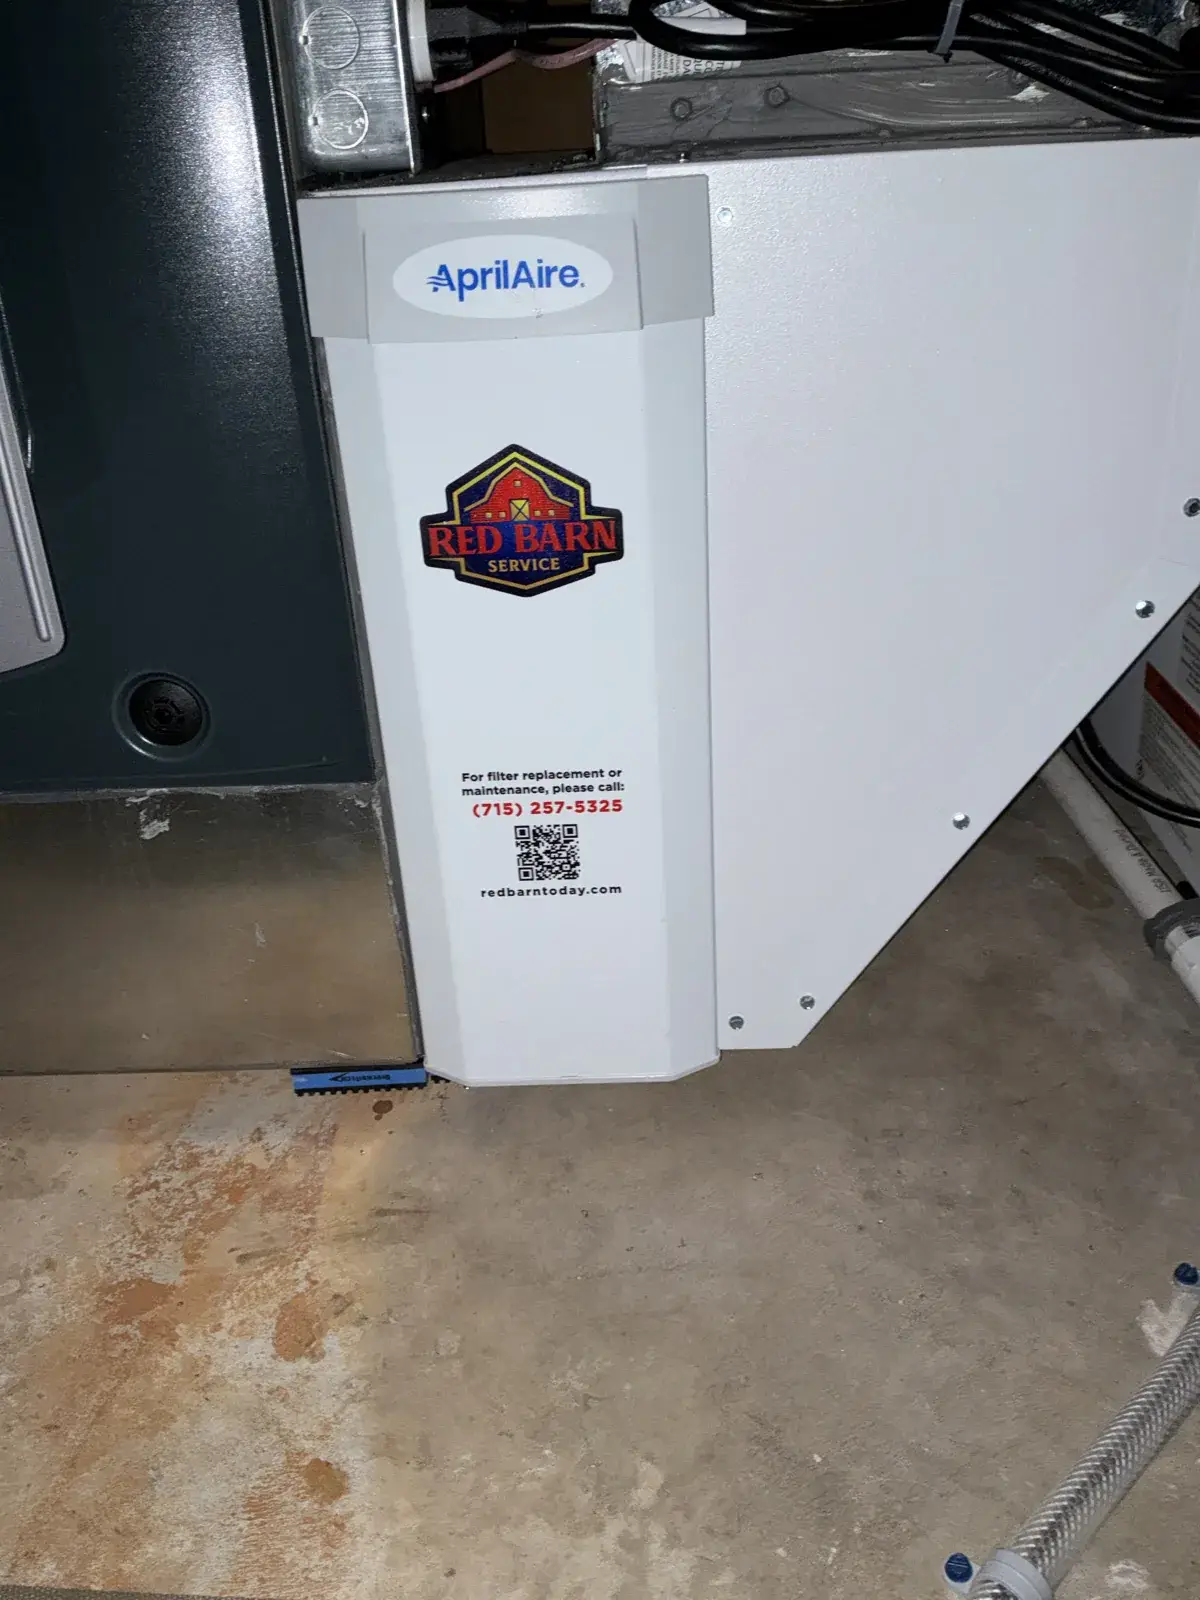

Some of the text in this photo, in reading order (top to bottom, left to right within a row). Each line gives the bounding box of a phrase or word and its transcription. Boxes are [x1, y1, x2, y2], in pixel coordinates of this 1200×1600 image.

[427, 259, 580, 302] AprilAire
[428, 520, 616, 556] RED BARN
[487, 557, 561, 573] SERVICE
[461, 769, 622, 783] For filter replacement or
[461, 781, 625, 797] maintenance, please call:
[472, 799, 623, 818] (715) 257-5325
[480, 885, 622, 898] redbarntoday.com
